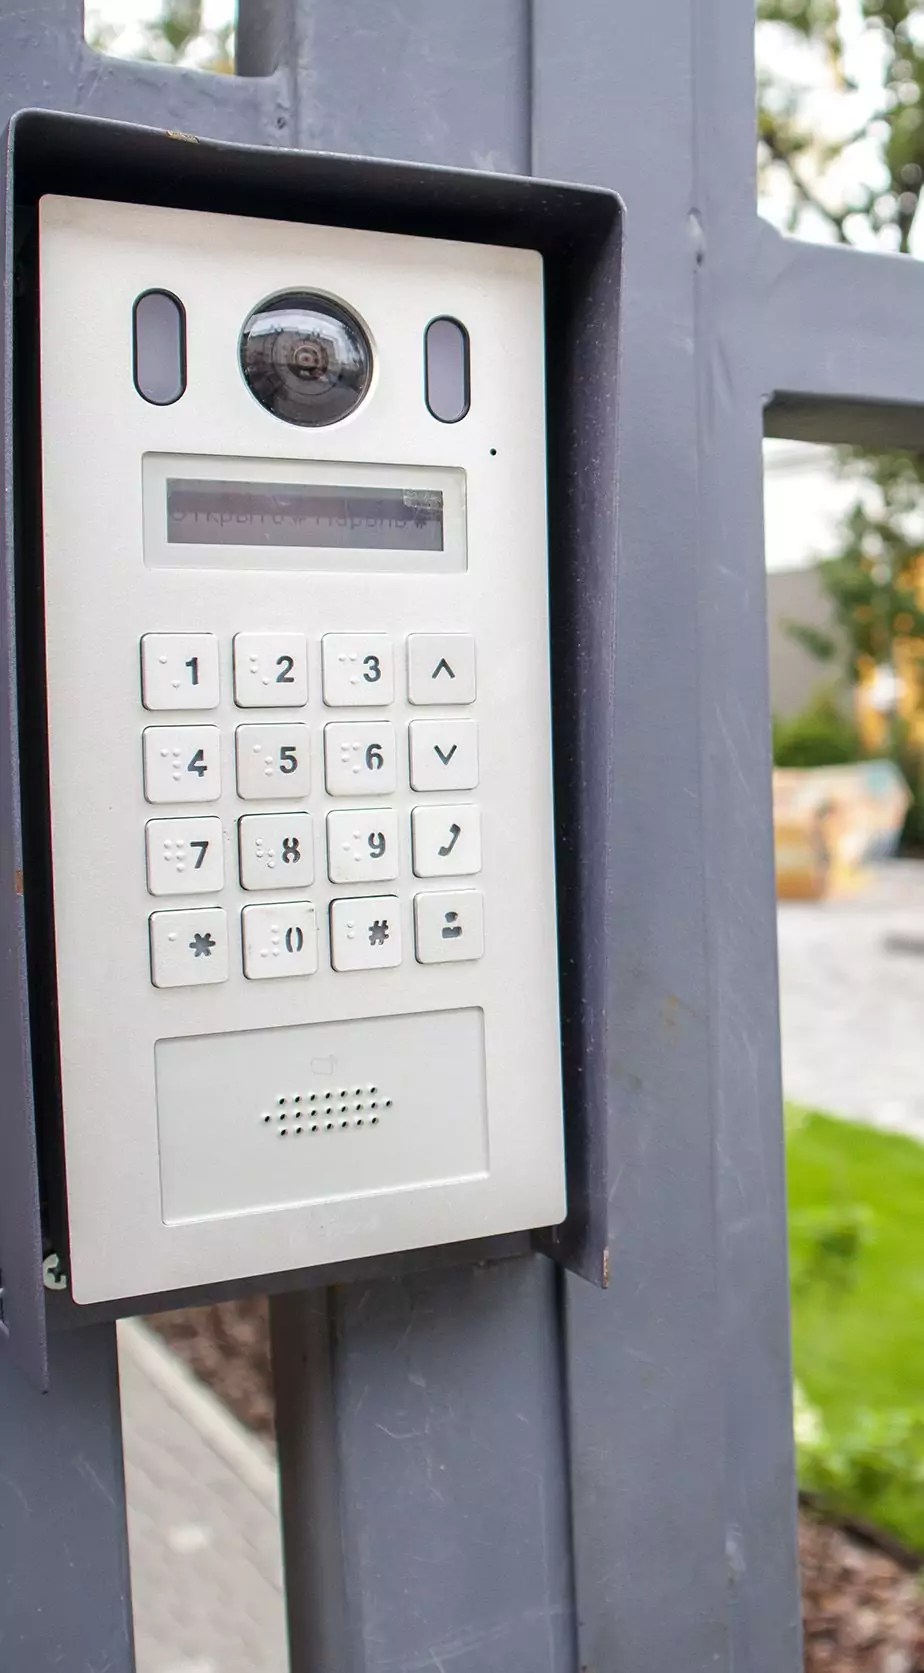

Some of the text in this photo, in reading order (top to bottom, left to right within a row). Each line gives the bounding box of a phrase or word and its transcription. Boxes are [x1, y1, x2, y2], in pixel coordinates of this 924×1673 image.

[185, 656, 199, 686] 1
[276, 655, 295, 684] 2
[363, 655, 381, 683] 3
[187, 749, 208, 778] 4
[279, 746, 298, 774] 5
[366, 743, 384, 770] 6
[190, 840, 209, 869] 7
[282, 836, 301, 864] 8
[368, 832, 386, 859] 9
[285, 926, 304, 953] 0
[368, 919, 390, 946] #
